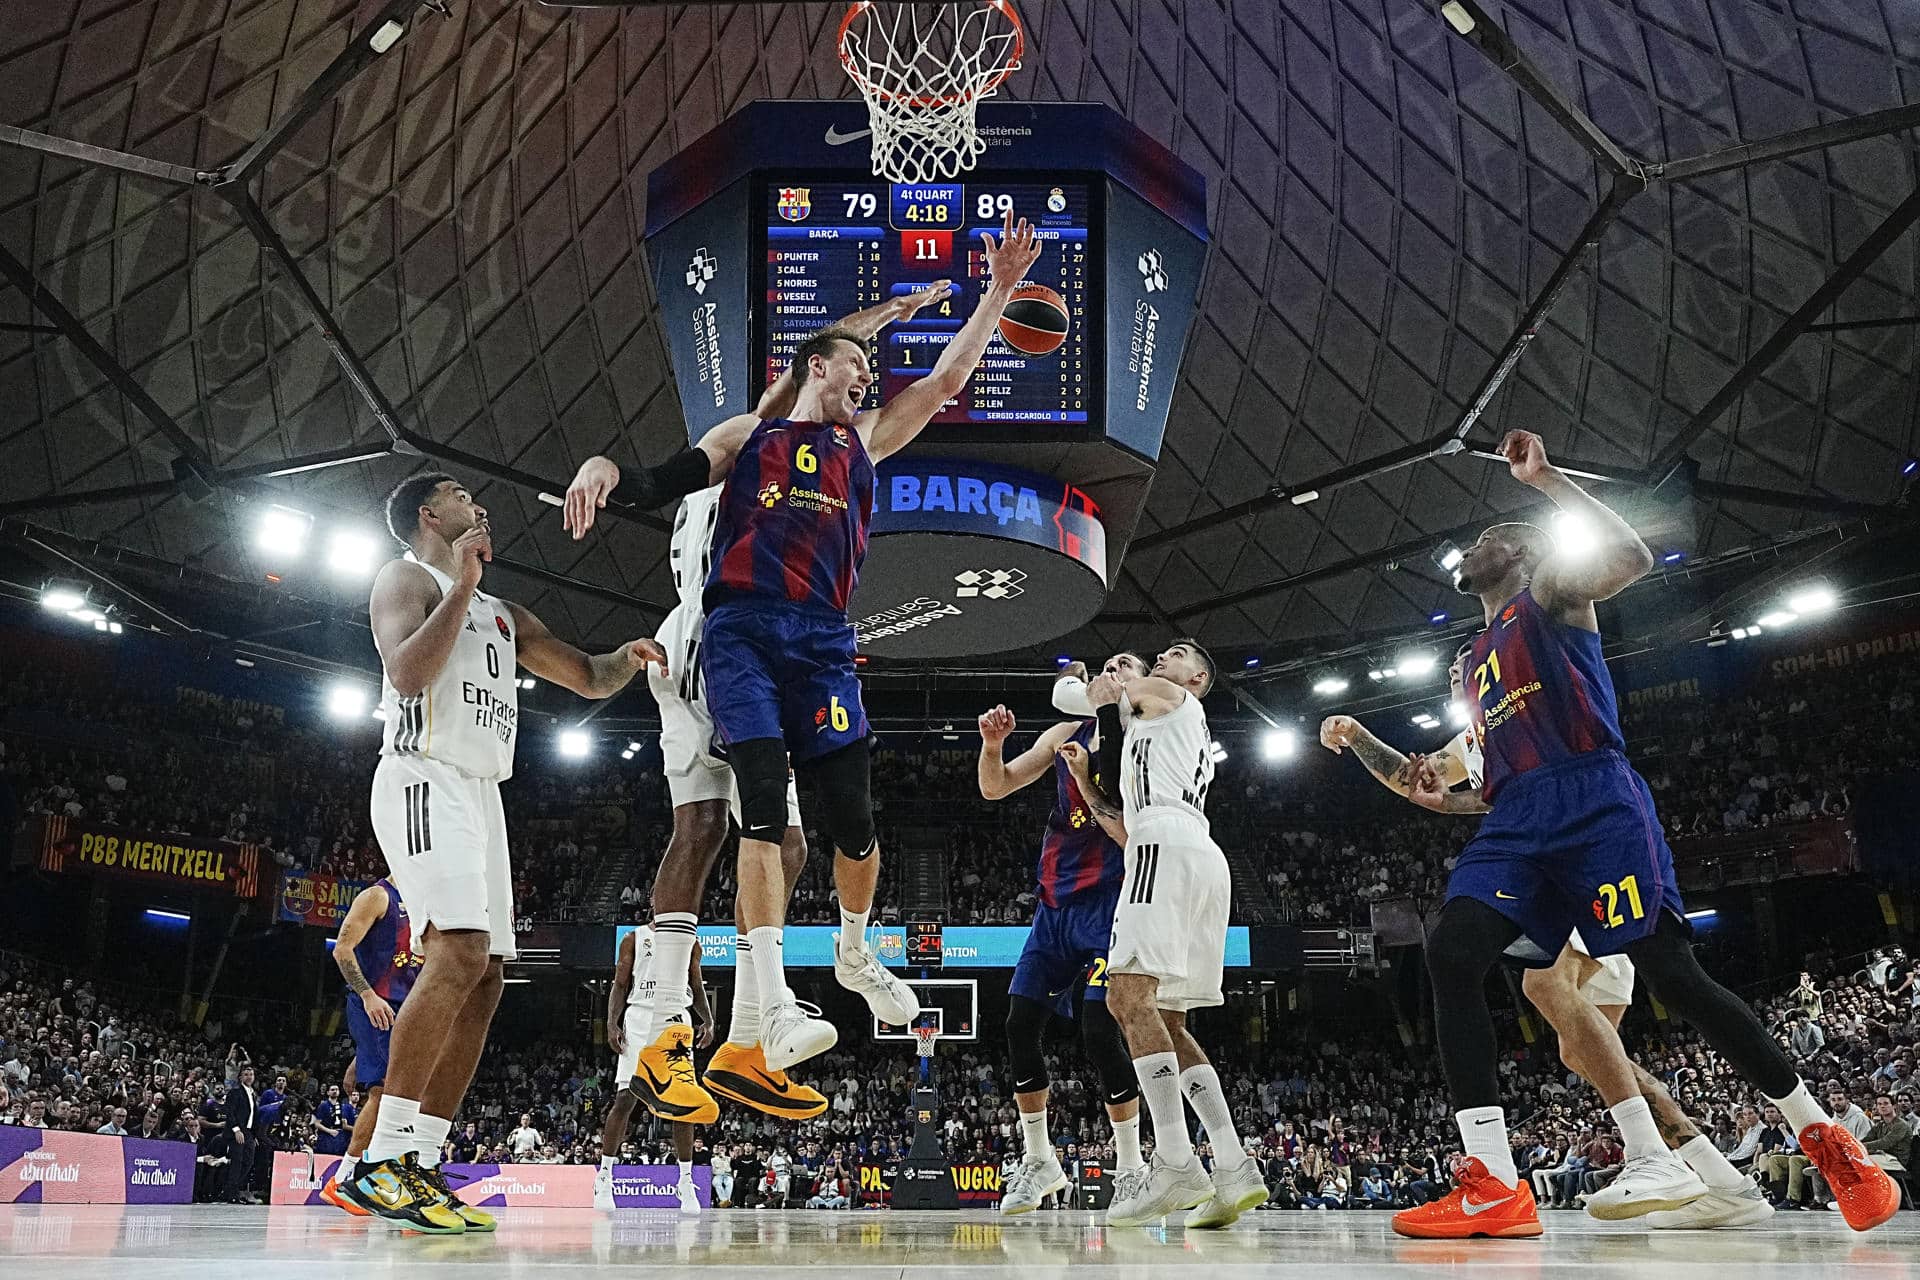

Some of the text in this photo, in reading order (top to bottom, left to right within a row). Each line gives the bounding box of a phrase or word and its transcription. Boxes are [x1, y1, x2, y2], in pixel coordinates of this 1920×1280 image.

[900, 189, 953, 200] 4t QUART
[842, 193, 877, 218] 79
[977, 193, 1014, 219] 89
[905, 204, 948, 222] 4:18
[808, 230, 839, 240] BARÇA
[914, 238, 939, 260] 11
[1062, 243, 1068, 251] F
[776, 252, 880, 261] 0 PUNTER 1 18
[1061, 254, 1066, 262] 1
[1073, 254, 1083, 262] 27
[777, 266, 878, 274] 3 CALE 2 2
[980, 267, 986, 275] 6
[1061, 268, 1067, 276] 0
[1075, 268, 1081, 276] 2
[776, 279, 878, 288] 5 NORRIS 0 0
[980, 280, 986, 288] 7
[1061, 281, 1067, 289] 4
[1073, 281, 1083, 289] 12
[776, 292, 880, 301] 6 VESELY 2 13
[1075, 294, 1081, 302] 3
[776, 306, 782, 314] 8
[783, 306, 827, 314] BRIZUELA
[939, 301, 951, 317] 4
[1073, 308, 1083, 316] 15
[1075, 321, 1081, 329] 7
[772, 332, 782, 341] 14
[897, 335, 927, 344] TEMPS
[1075, 335, 1081, 343] 4
[1129, 298, 1148, 373] Sanitària
[692, 307, 710, 383] Sanitària
[772, 346, 782, 354] 19
[872, 346, 878, 354] 0
[704, 302, 727, 408] Assistència
[903, 349, 913, 366] 1
[1136, 305, 1160, 411] Assistència
[770, 359, 781, 367] 20
[872, 359, 878, 367] 5
[987, 360, 1026, 368] TAVARES
[1060, 361, 1067, 369] 0
[1075, 361, 1081, 369] 5
[975, 373, 1081, 382] 23 LLULL 0 0
[870, 386, 879, 394] 11
[974, 387, 985, 395] 24
[987, 387, 1012, 395] FELIZ
[974, 400, 985, 408] 25
[987, 400, 1003, 408] LEN
[1060, 412, 1067, 420] 0
[795, 444, 817, 474] 6
[788, 486, 848, 510] Assistència
[890, 475, 1043, 528] BARÇA
[788, 496, 832, 514] Sanitària
[486, 642, 500, 679] 0
[1474, 648, 1501, 702] 21
[1484, 681, 1542, 721] Assistència
[830, 695, 850, 733] 6
[1486, 699, 1526, 731] Sanitària
[79, 832, 225, 882] PBB MERITXELL
[1600, 875, 1647, 929] 21
[919, 936, 940, 952] 24
[701, 946, 728, 958] ARÇA
[1088, 957, 1110, 987] 2
[19, 1162, 81, 1183] abu dhabi
[131, 1168, 177, 1186] abu dhabi
[1084, 1167, 1102, 1178] 79
[479, 1182, 546, 1196] abu dhabi
[613, 1183, 677, 1197] abu dhab
[1087, 1194, 1096, 1204] 2
